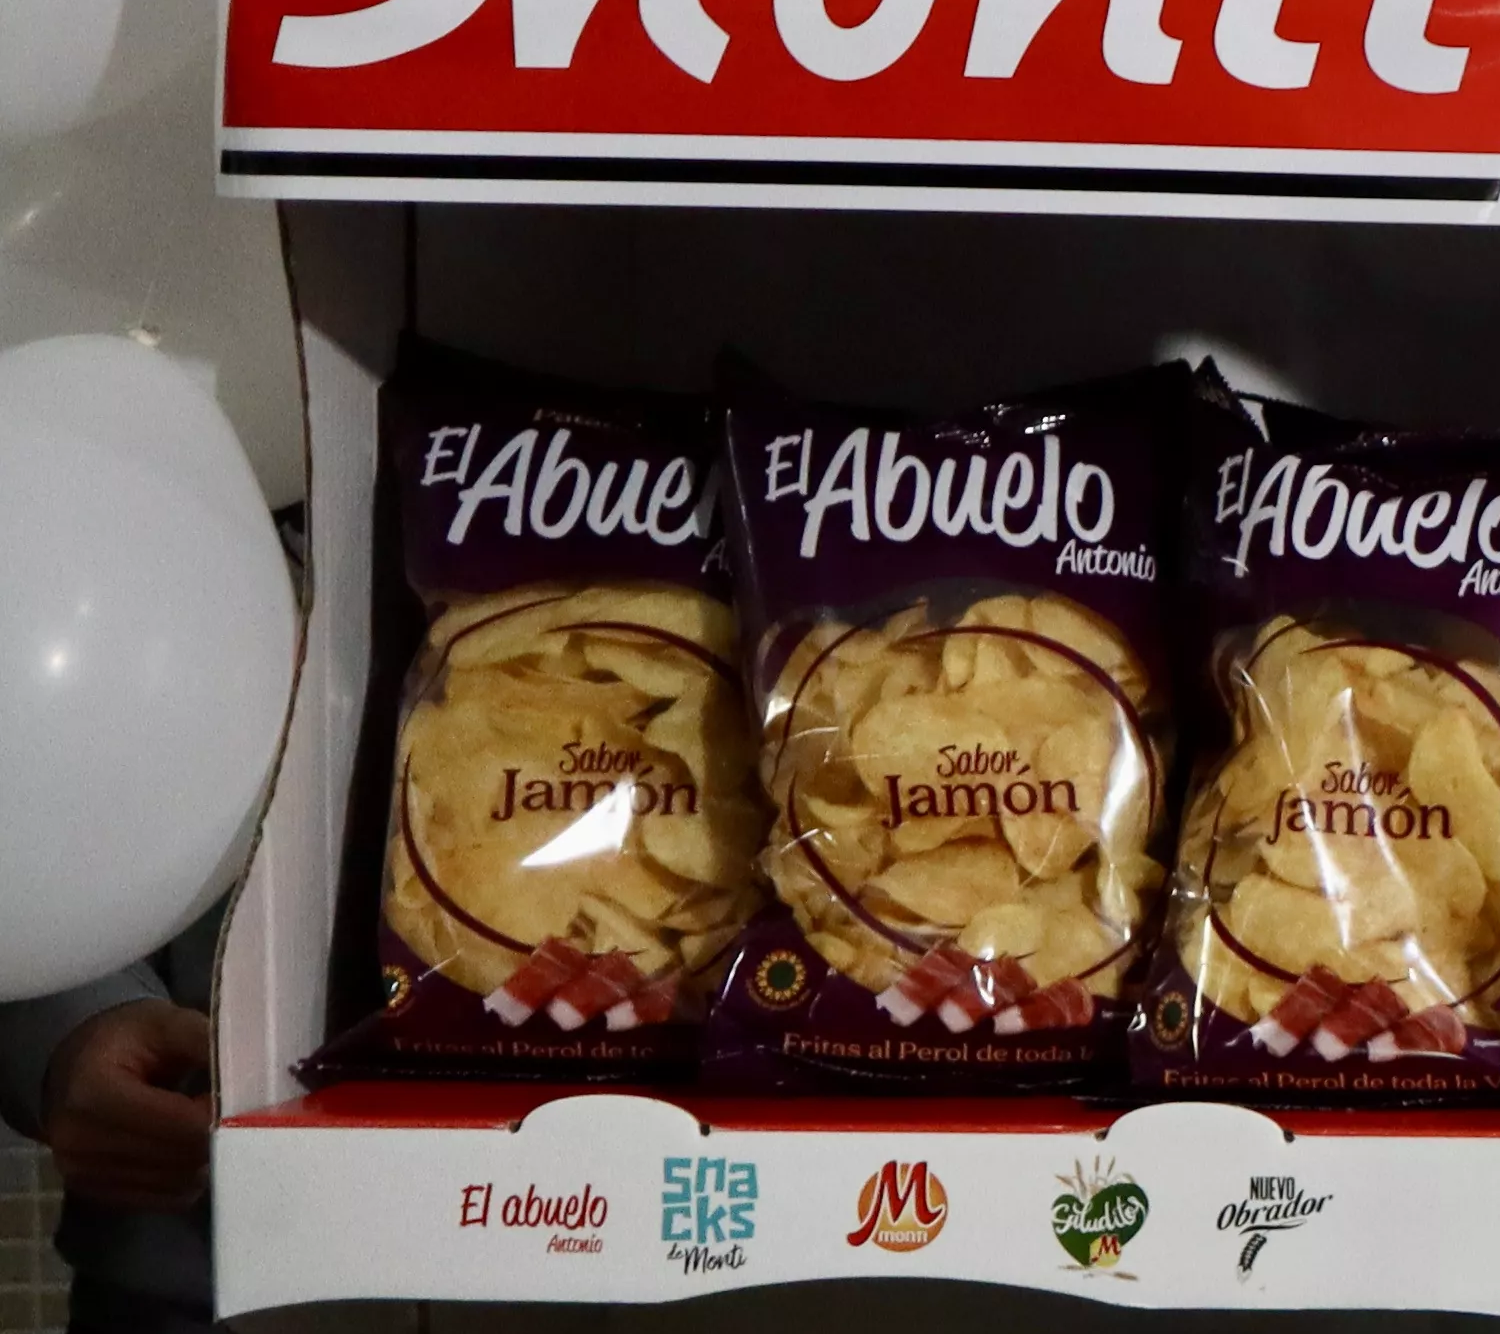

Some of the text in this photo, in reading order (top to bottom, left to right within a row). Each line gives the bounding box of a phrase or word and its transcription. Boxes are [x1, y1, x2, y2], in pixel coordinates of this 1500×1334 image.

[420, 423, 482, 486] El
[764, 428, 1115, 558] El Abuelo
[1216, 448, 1253, 523] El
[1055, 540, 1155, 583] Antonio
[560, 741, 642, 775] Sabor
[936, 742, 1022, 778] Sabor
[1320, 761, 1401, 796] Sabor
[491, 766, 699, 821] Jamón
[881, 762, 1079, 828] Jamón
[1267, 786, 1453, 845] Jamón
[783, 1032, 861, 1059] Fritas
[868, 1039, 891, 1060] al
[900, 1041, 969, 1063] Perol
[976, 1043, 1008, 1063] de
[1015, 1045, 1072, 1064] toda
[1278, 1072, 1345, 1090] Perol
[1353, 1072, 1385, 1090] de
[1392, 1071, 1448, 1091] toda
[1455, 1072, 1477, 1090] la
[460, 1184, 608, 1228] El abuelo
[1250, 1176, 1296, 1200] NUEVO
[1216, 1189, 1334, 1231] Obrador
[547, 1233, 603, 1255] Antonio
[683, 1244, 747, 1276] Monti
